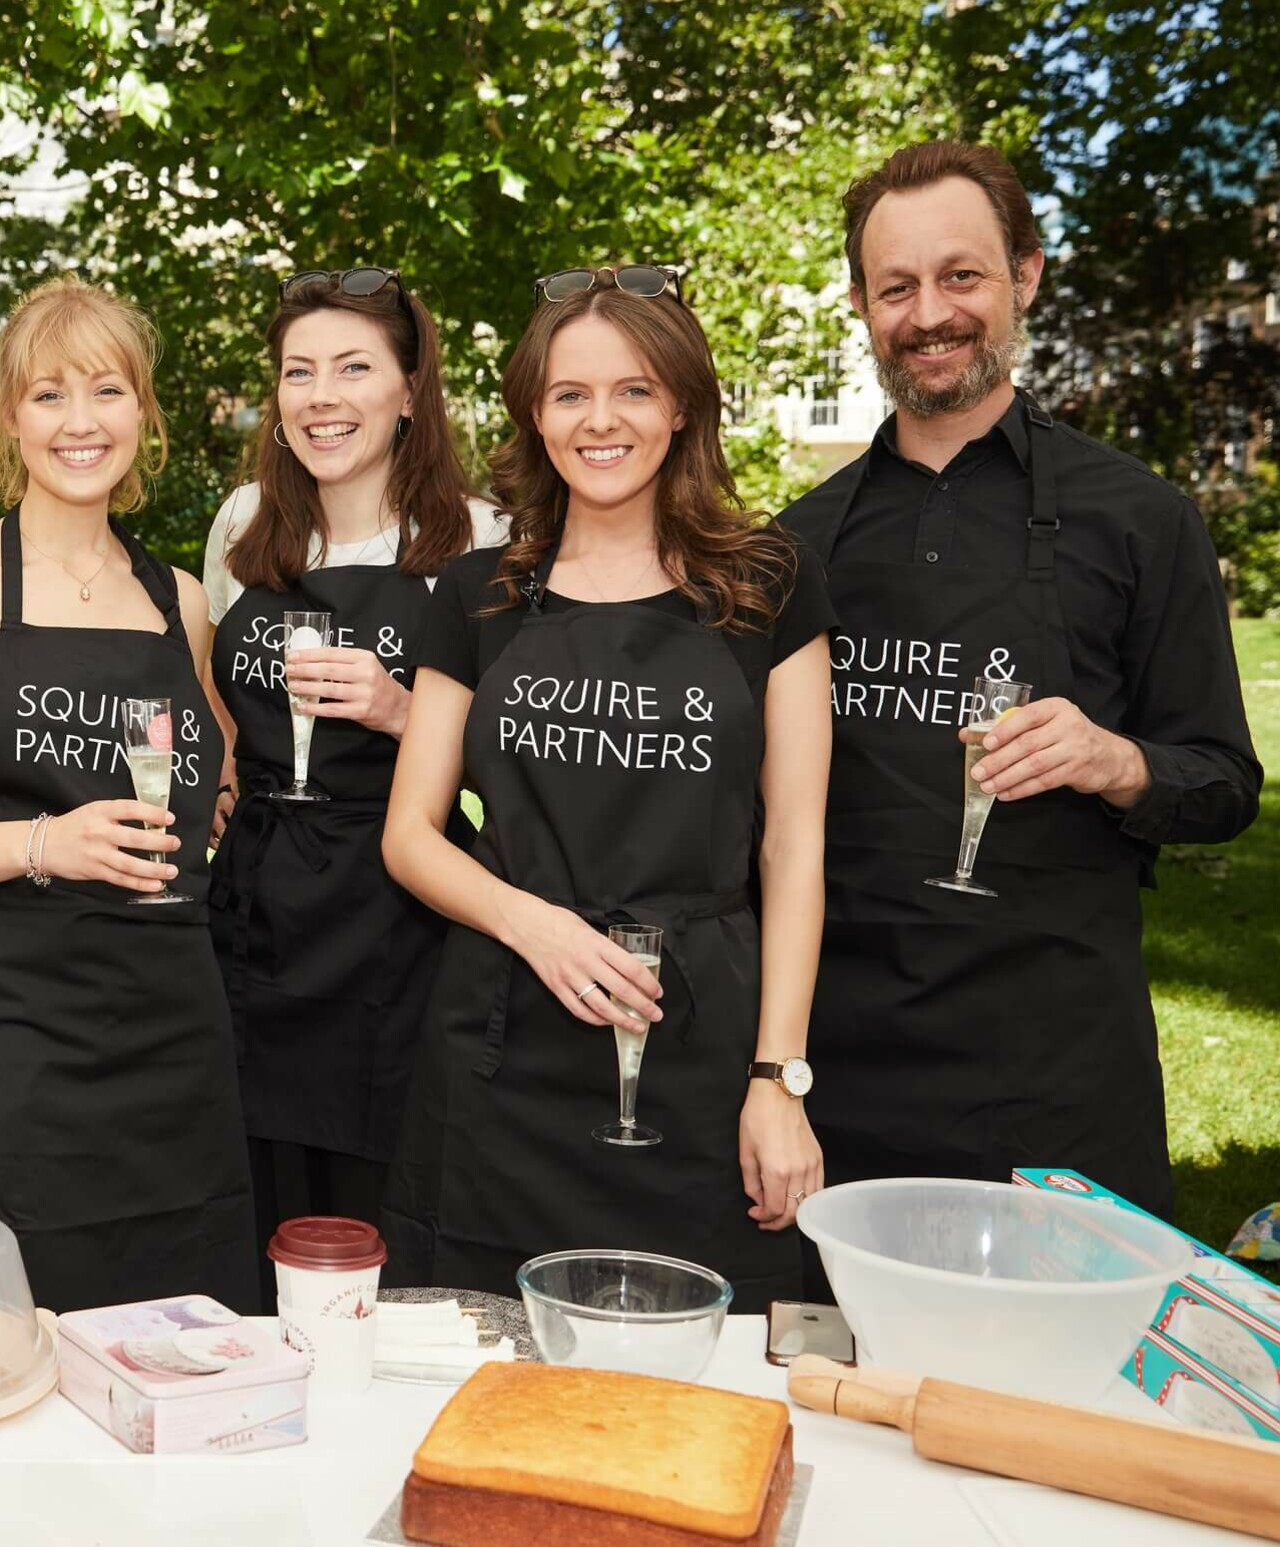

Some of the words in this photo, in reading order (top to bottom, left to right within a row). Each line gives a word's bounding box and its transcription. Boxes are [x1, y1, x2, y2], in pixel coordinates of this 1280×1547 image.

[377, 626, 404, 658] &
[829, 635, 962, 678] QUIRE
[984, 647, 1016, 683] &
[504, 674, 661, 720] SQUIRE
[684, 687, 715, 722] &
[830, 681, 1011, 726] ARTNERS
[180, 709, 201, 743] &
[499, 716, 713, 772] PARTNERS
[15, 728, 201, 787] PARTNRS
